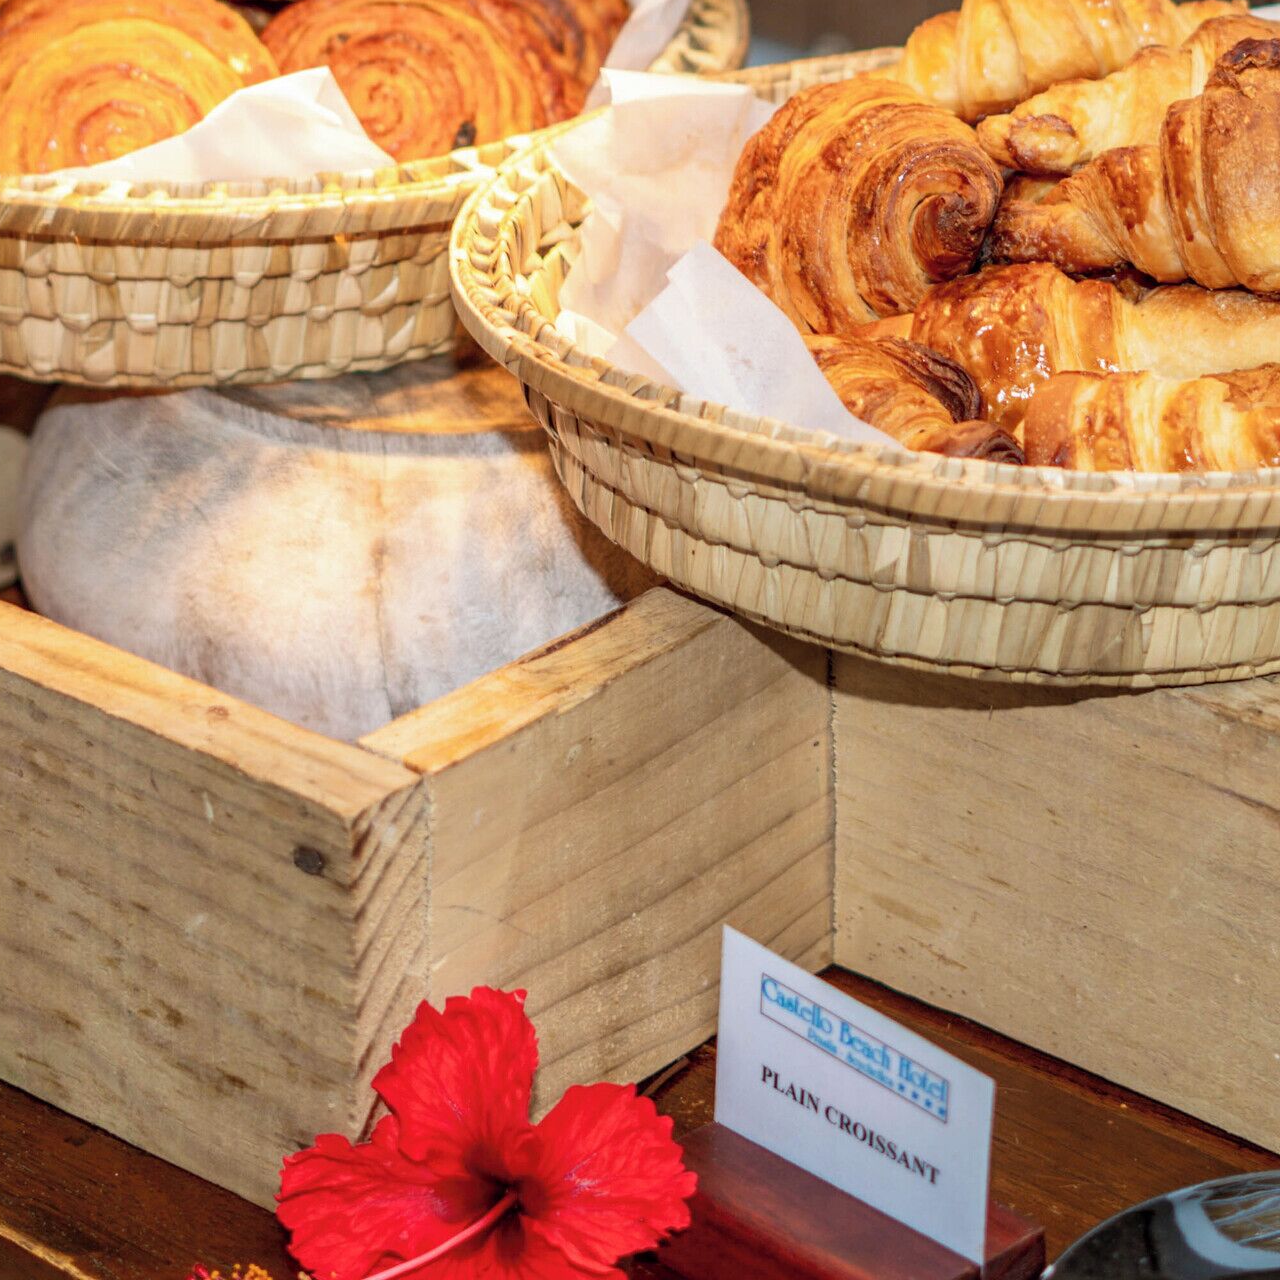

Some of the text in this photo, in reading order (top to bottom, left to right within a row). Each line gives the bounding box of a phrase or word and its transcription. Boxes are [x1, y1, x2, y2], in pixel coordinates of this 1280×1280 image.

[762, 978, 832, 1034] Castello
[840, 1020, 890, 1069] Beach
[899, 1056, 947, 1101] Hotel
[761, 1064, 940, 1185] PLAIN CROISSANT
